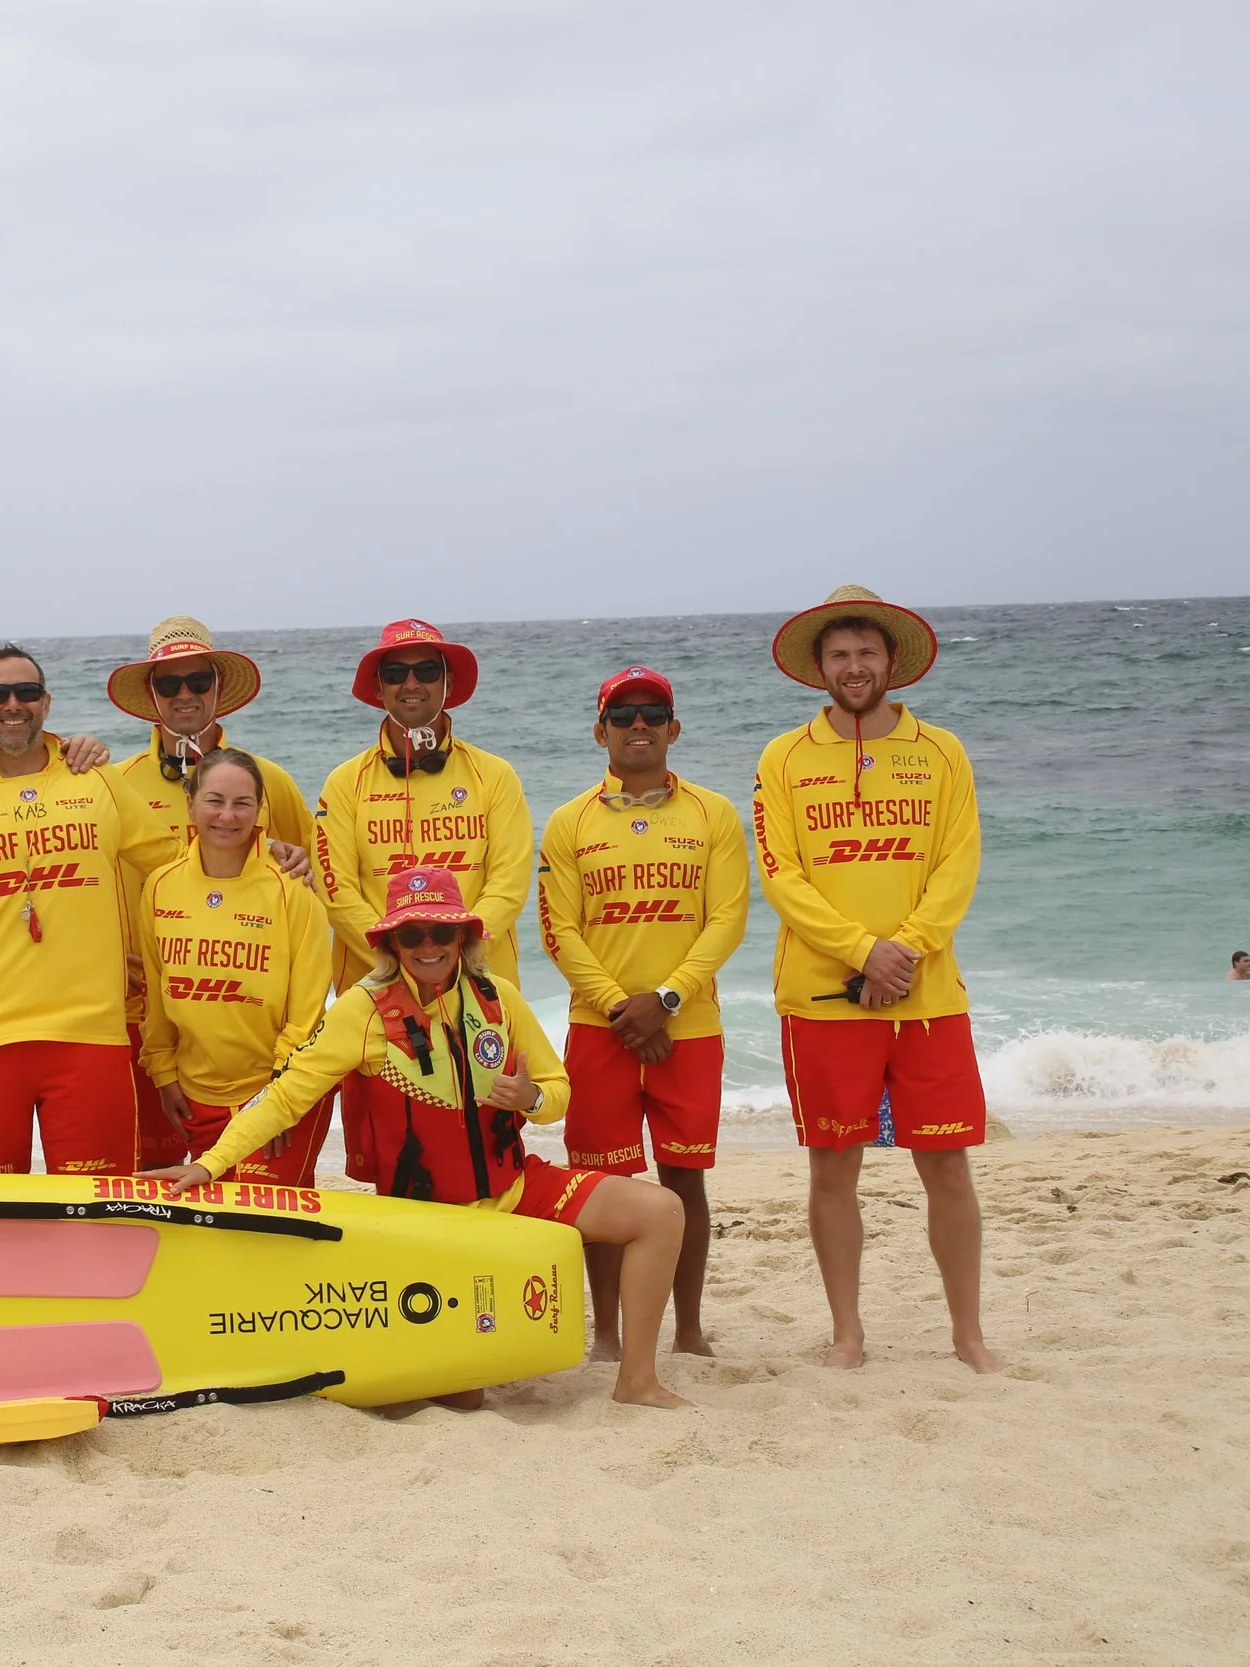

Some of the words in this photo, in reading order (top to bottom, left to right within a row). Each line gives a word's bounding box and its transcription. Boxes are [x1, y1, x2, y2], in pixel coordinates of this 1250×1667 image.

[395, 630, 414, 641] SURF
[170, 643, 189, 652] SURF
[891, 754, 929, 768] RICH
[798, 775, 839, 788] DHL
[891, 772, 932, 780] ISUZU
[54, 797, 94, 807] ISUZU
[367, 792, 407, 802] DHL
[12, 802, 47, 822] KAB
[805, 800, 855, 832] SURF
[861, 798, 933, 827] RESCUE
[25, 822, 99, 857] RESCUE
[367, 818, 415, 845] SURF
[419, 813, 486, 843] RESCUE
[752, 800, 780, 880] AMPOL
[574, 841, 611, 859] DHL
[663, 836, 705, 848] ISUZU
[827, 837, 917, 865] DHL
[314, 824, 341, 903] AMPOL
[386, 850, 474, 876] DHL
[583, 864, 627, 897] SURF
[633, 861, 703, 890] RESCUE
[396, 896, 413, 908] SURF
[414, 891, 445, 903] RESCUE
[155, 908, 186, 919] DHL
[233, 912, 273, 925] ISUZU
[538, 879, 562, 963] AMPOL
[600, 899, 684, 925] DHL
[240, 921, 264, 929] UTE
[197, 937, 272, 973] RESCUE
[168, 975, 248, 1003] DHL
[465, 1012, 482, 1033] 18
[478, 1030, 497, 1040] SURF
[475, 1051, 489, 1068] LIFE
[489, 1046, 505, 1069] SAVING
[920, 1120, 968, 1136] DHL
[581, 1152, 605, 1167] SURF
[607, 1143, 643, 1166] RESCUE
[669, 1141, 714, 1155] DHL
[64, 1157, 112, 1172] DHL
[92, 1176, 225, 1205] RESCUE
[234, 1184, 322, 1215] SURF
[553, 1172, 588, 1211] DHL
[104, 1201, 173, 1220] KRACKA
[304, 1280, 389, 1304] BANK
[549, 1263, 558, 1304] Rescue
[208, 1306, 389, 1335] MACQUARIE
[549, 1303, 560, 1335] Surf
[112, 1399, 176, 1413] KRACKA
